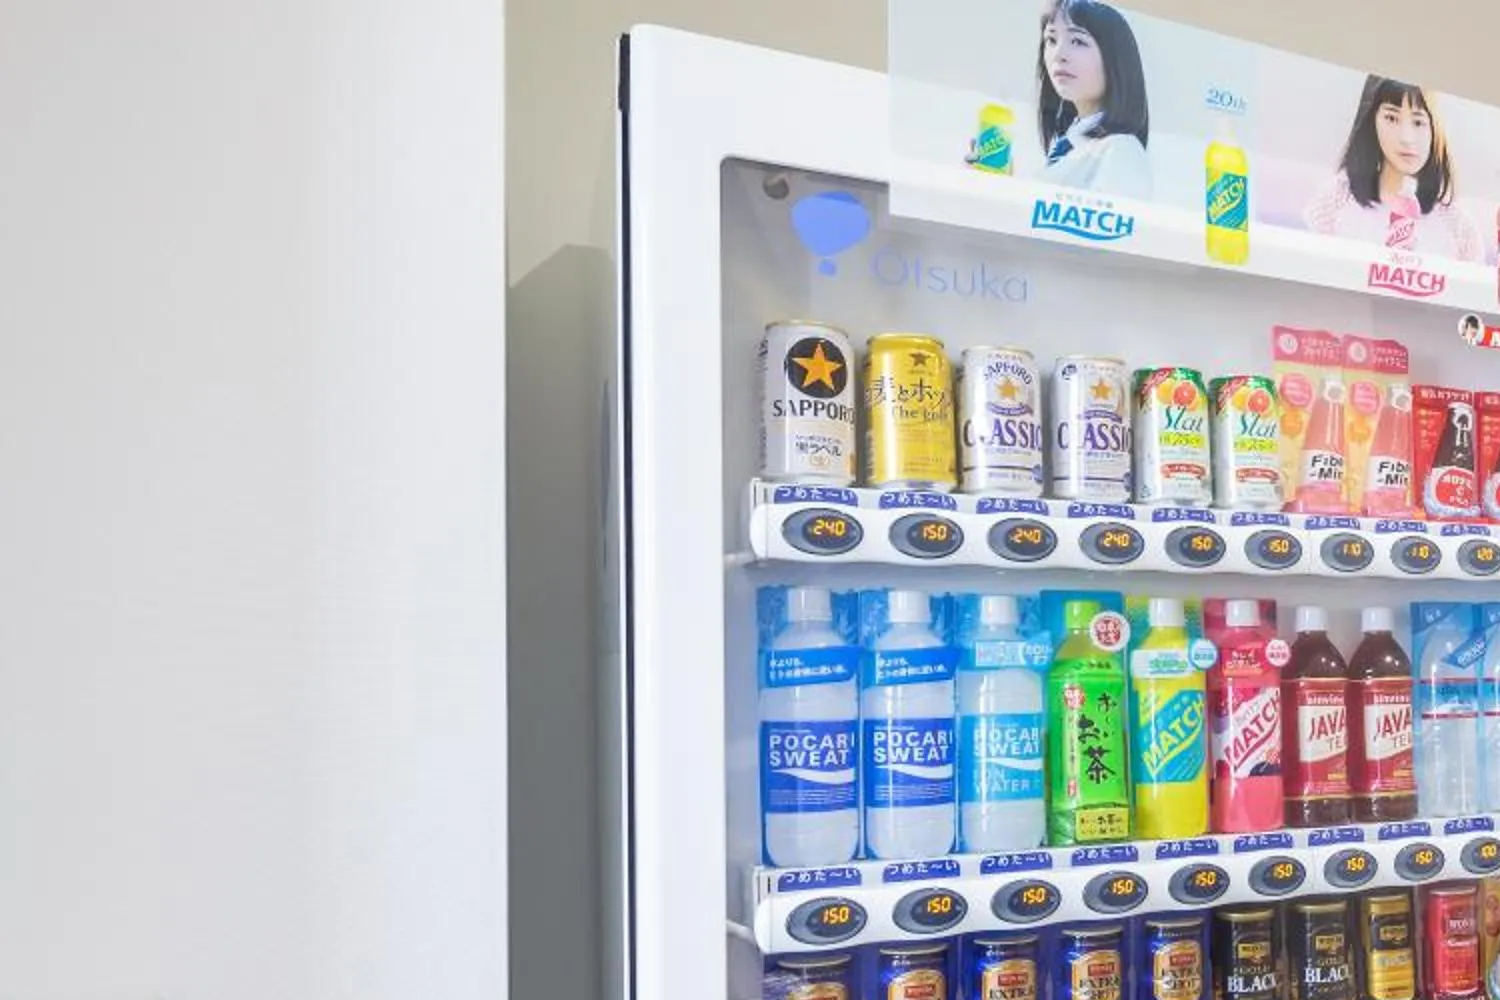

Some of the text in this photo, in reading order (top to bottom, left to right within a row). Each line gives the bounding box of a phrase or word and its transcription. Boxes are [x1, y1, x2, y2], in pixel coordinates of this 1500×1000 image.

[1032, 199, 1134, 241] MATCH
[870, 248, 1030, 303] Otsuka
[1369, 263, 1446, 297] MATCH
[813, 520, 845, 535] 240
[922, 525, 947, 540] 150
[1013, 528, 1041, 543] 240
[1103, 532, 1130, 547] 240
[1191, 535, 1213, 550] 150
[1269, 539, 1289, 553] 150
[1309, 710, 1346, 742] JAVA
[1374, 706, 1412, 741] JAVA
[769, 732, 855, 749] POCARI
[873, 730, 953, 747] POCARI
[769, 750, 849, 767] SWEAT
[873, 746, 949, 764] SWEAT
[1274, 864, 1292, 878] 150
[1347, 858, 1364, 871] 150
[1112, 880, 1133, 894] 150
[1196, 872, 1216, 886] 150
[1023, 887, 1046, 903] 150
[928, 897, 951, 913] 150
[824, 907, 849, 924] 150
[989, 985, 1035, 1000] EXTRA
